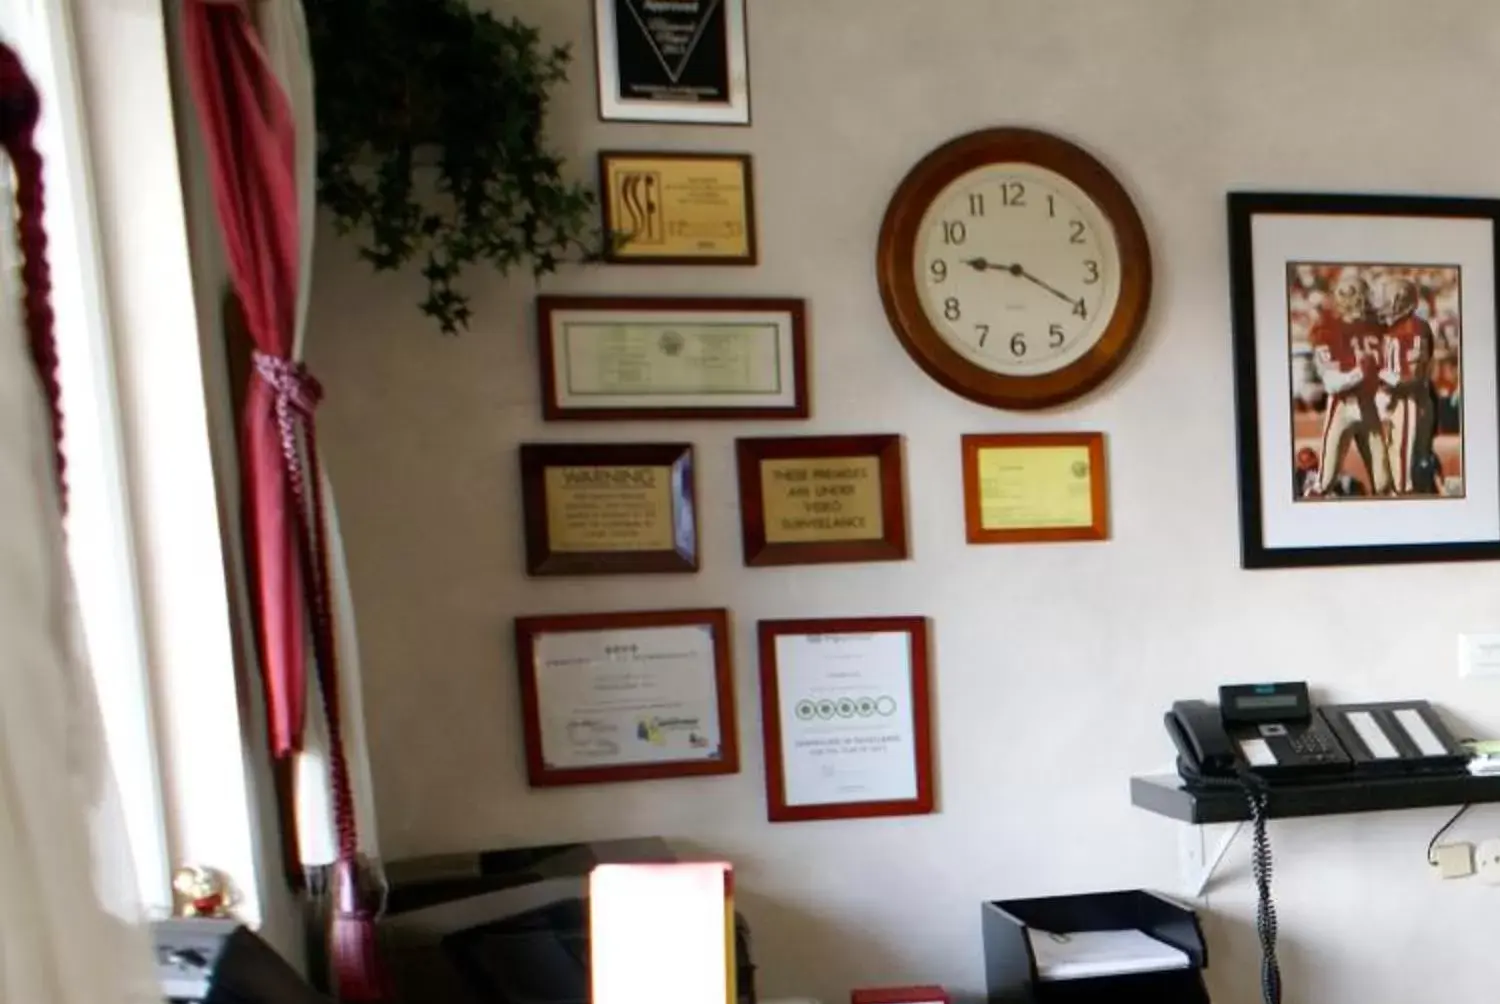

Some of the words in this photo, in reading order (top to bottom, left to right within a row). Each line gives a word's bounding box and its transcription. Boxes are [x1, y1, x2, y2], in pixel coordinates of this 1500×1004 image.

[968, 193, 985, 217] 11
[1000, 181, 1027, 207] 12
[1046, 194, 1056, 219] 1
[942, 220, 967, 246] 10
[1068, 219, 1087, 245] 2
[930, 258, 948, 284] 9
[1082, 259, 1100, 285] 3
[943, 296, 962, 322] 8
[974, 323, 990, 349] 7
[1009, 332, 1027, 358] 6
[1048, 324, 1066, 349] 5
